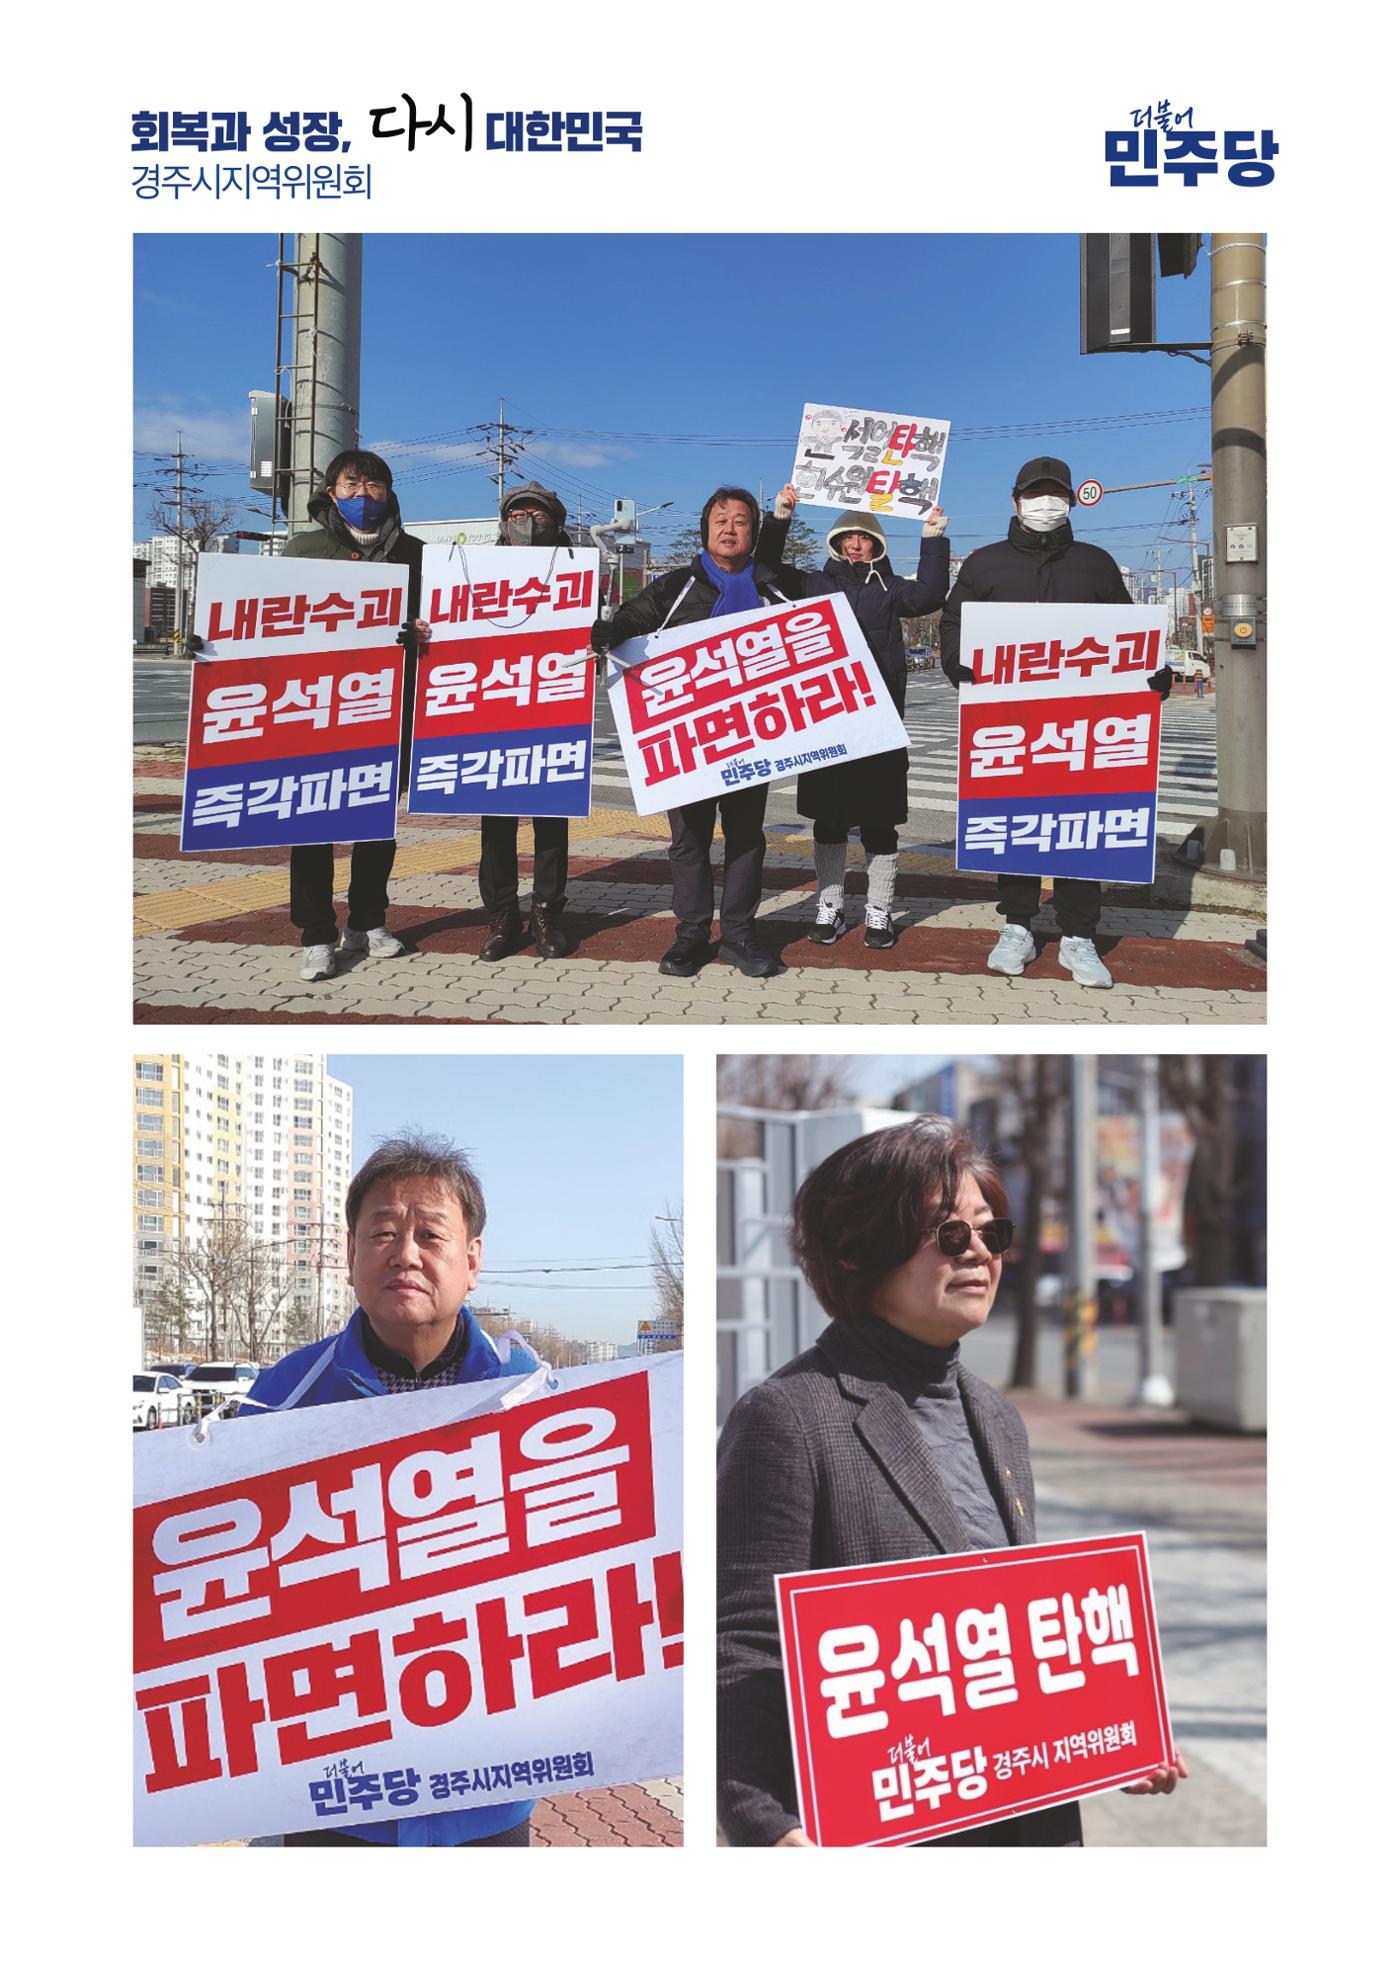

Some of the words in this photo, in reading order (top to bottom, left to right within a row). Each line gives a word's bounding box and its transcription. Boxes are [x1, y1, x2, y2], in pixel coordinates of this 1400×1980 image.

[1083, 486, 1098, 500] 50
[207, 587, 403, 642] 내란수괴
[430, 570, 594, 624] 내란수괴
[425, 648, 588, 717] 윤석열
[640, 611, 835, 719] 윤석열을
[970, 630, 1161, 686] 내란수괴
[202, 668, 395, 745] 윤석열
[637, 660, 877, 788] 파면하라!
[417, 740, 587, 795] 즉각파면
[720, 758, 772, 787] 민주당
[774, 743, 848, 772] 경주시지역위원회
[969, 713, 1152, 779] 윤석열
[192, 761, 393, 828] 즉각파면
[964, 807, 1150, 855] 즉각파면
[152, 1406, 630, 1642] 윤석열을
[135, 1550, 684, 1794] 파면하라!
[817, 1602, 1019, 1739] 윤석열
[1028, 1583, 1140, 1695] 탄핵
[323, 1758, 365, 1779] 더불어
[871, 1746, 988, 1822] 민주당
[992, 1742, 1049, 1780] 경주시
[1053, 1720, 1137, 1764] 지역위원회
[887, 1733, 932, 1767] 더불어
[309, 1768, 421, 1816] 민주당
[429, 1751, 595, 1799] 경주시지역위원회
